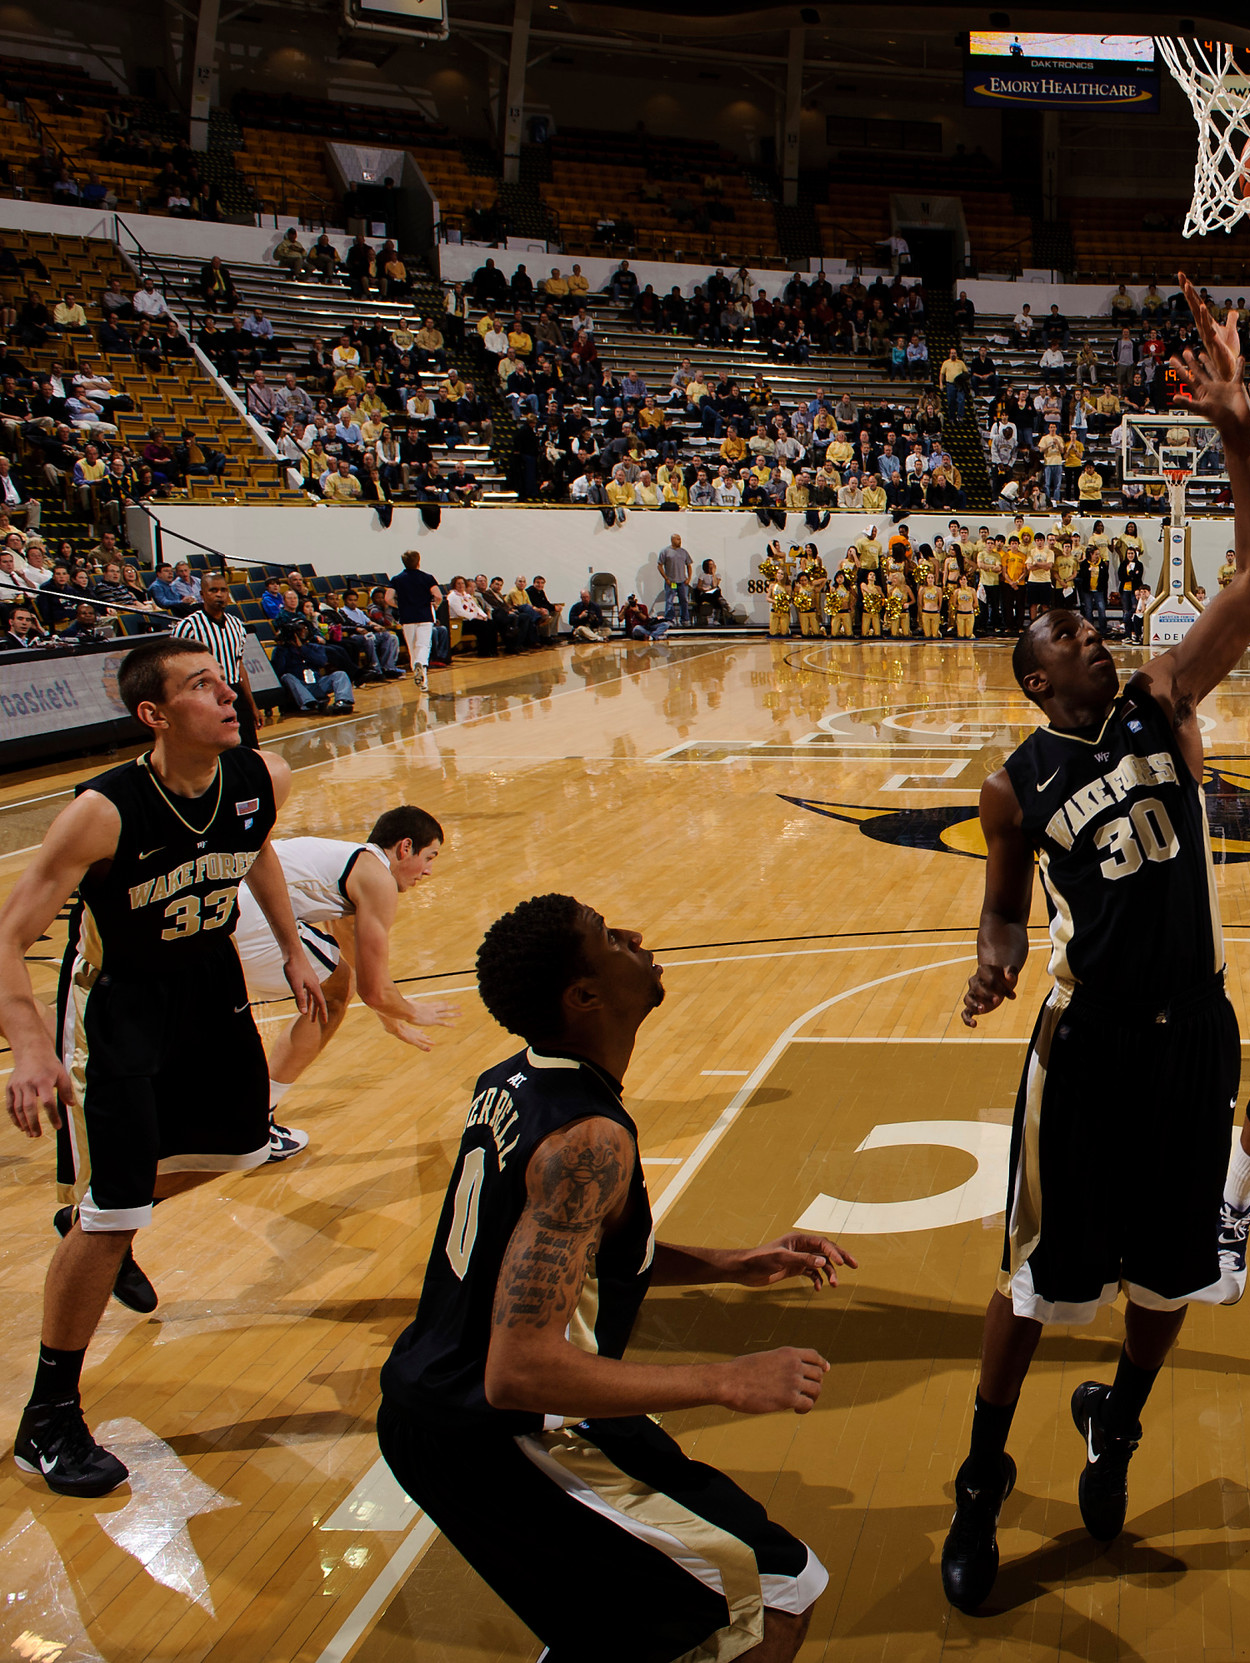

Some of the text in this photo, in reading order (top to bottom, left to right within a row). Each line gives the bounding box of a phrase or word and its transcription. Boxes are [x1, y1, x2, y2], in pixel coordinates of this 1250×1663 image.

[989, 77, 1137, 97] EMORY HEALTHCARE
[1031, 60, 1094, 70] DAKTRONICS
[1045, 752, 1180, 852] WAKE FORES
[1093, 797, 1181, 881] 30
[128, 850, 262, 910] WAKE FORES
[161, 885, 240, 941] 33
[463, 1087, 520, 1173] ERRELL
[446, 1147, 486, 1282] 0
